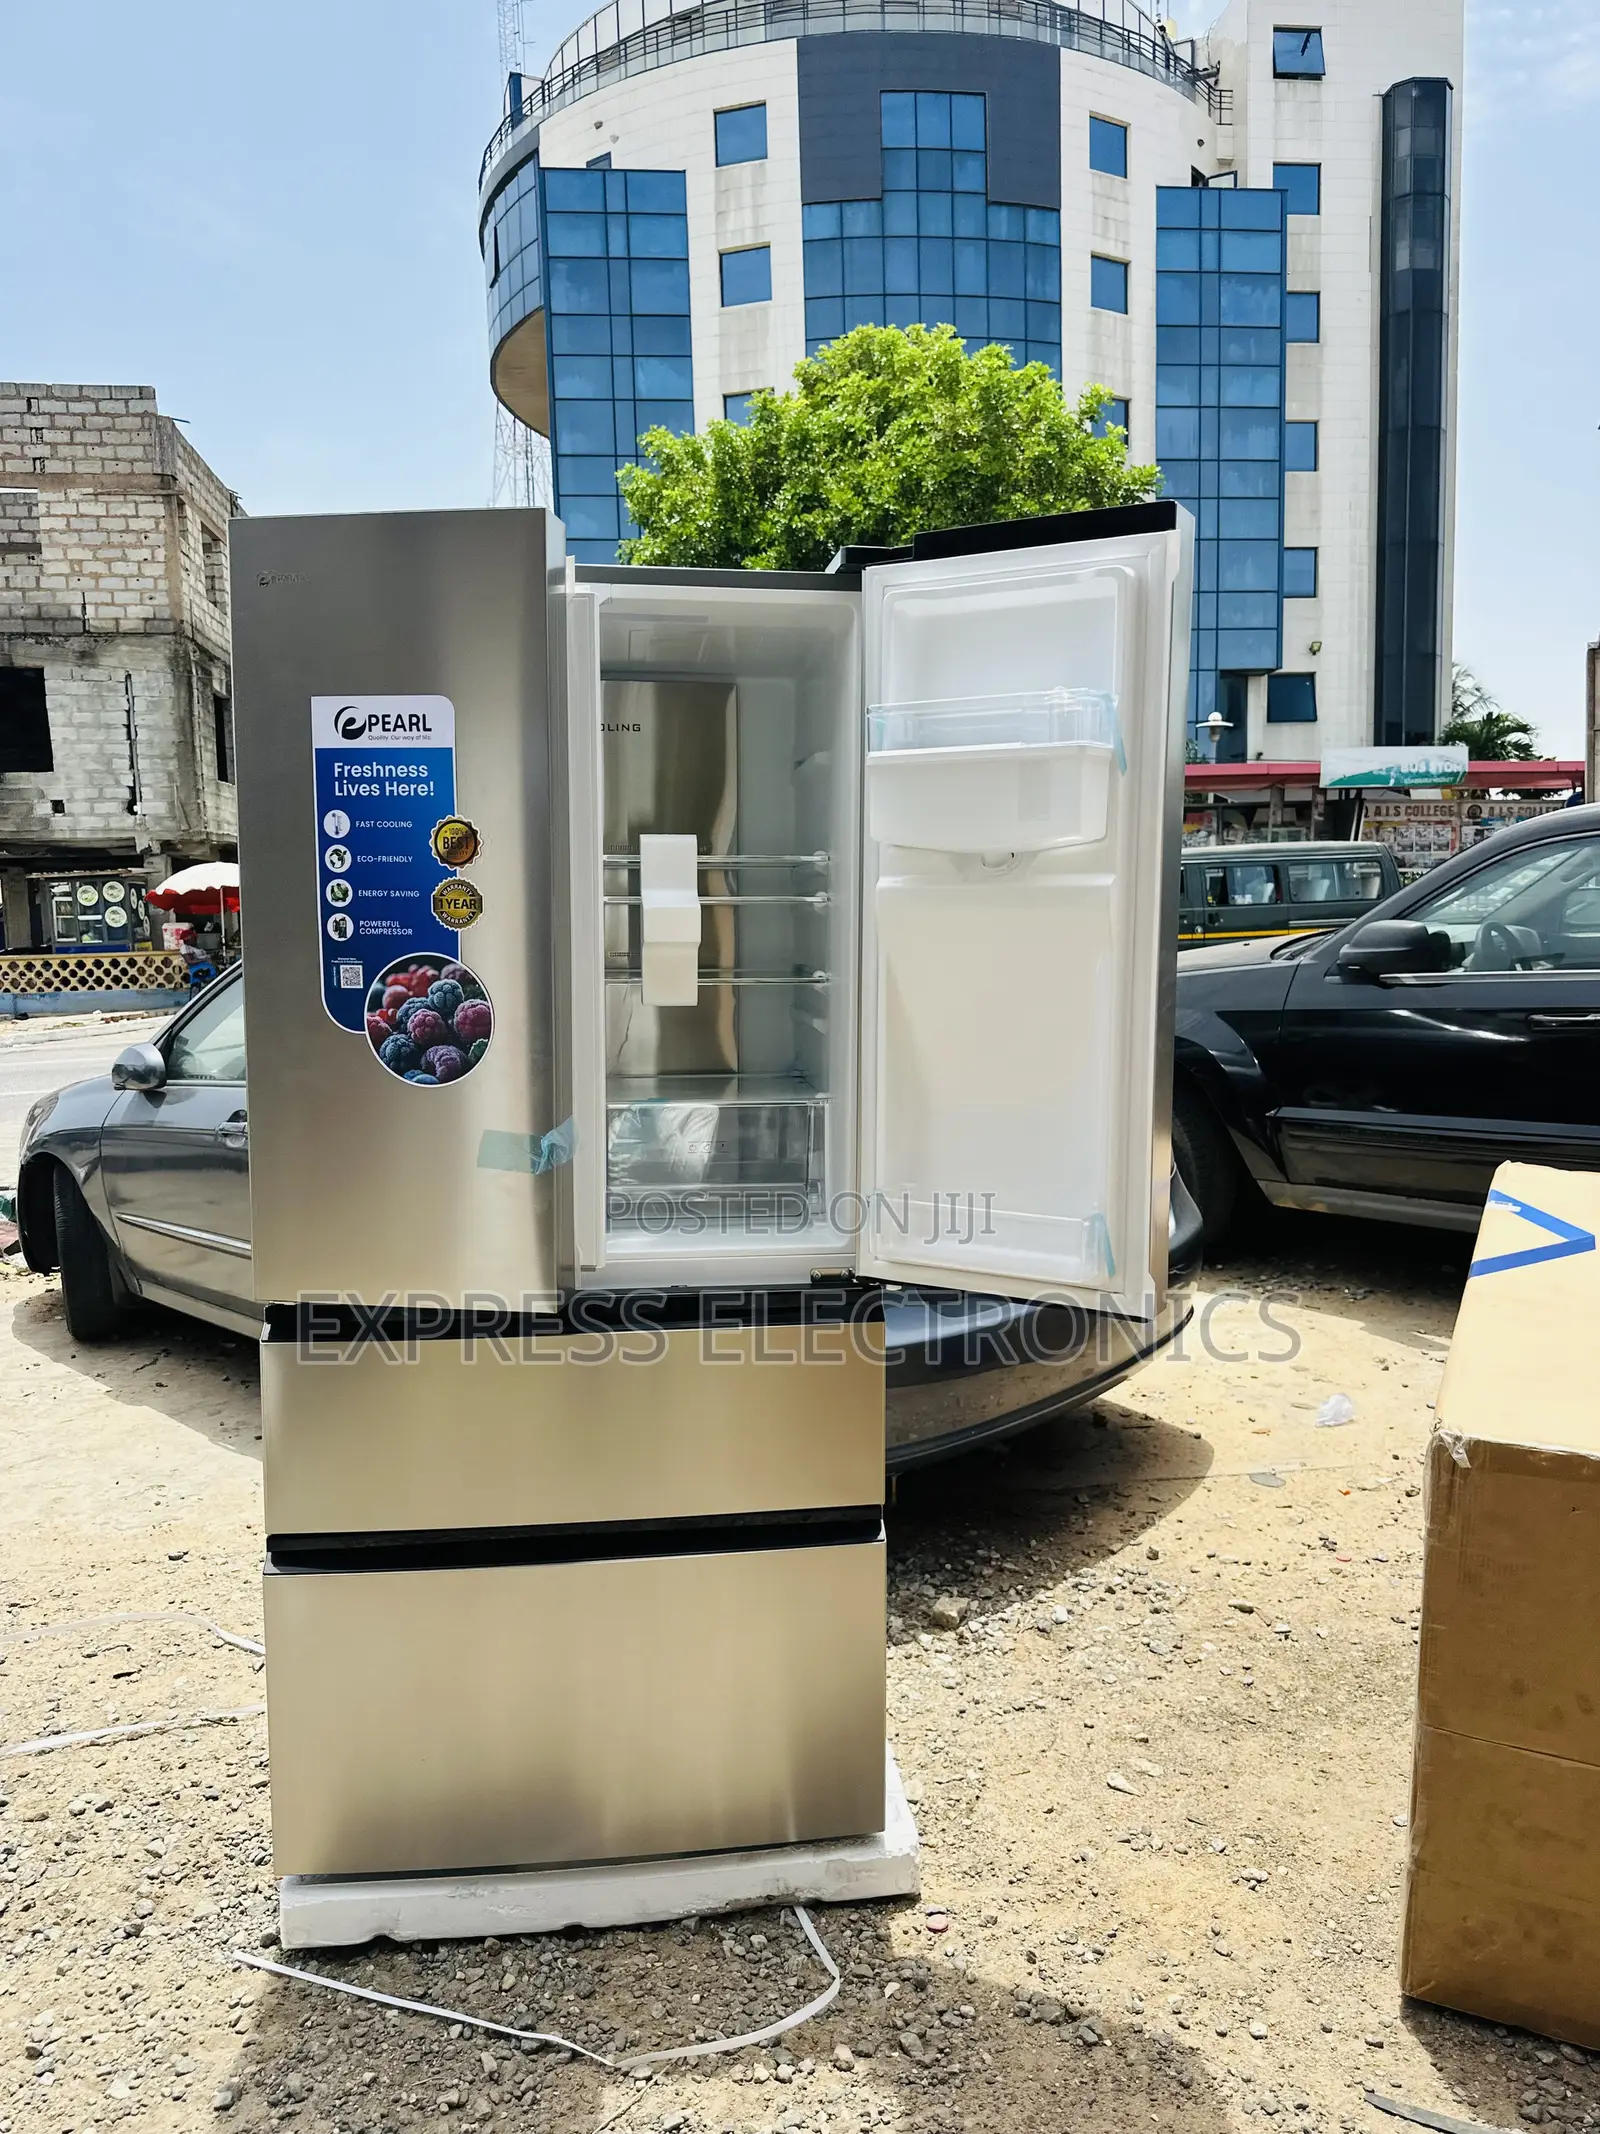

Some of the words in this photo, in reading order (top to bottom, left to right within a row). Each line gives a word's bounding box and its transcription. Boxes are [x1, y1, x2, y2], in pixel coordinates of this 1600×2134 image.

[367, 713, 432, 732] PEARL
[333, 761, 429, 778] Freshness
[334, 780, 381, 797] Lives
[384, 781, 435, 797] Here!
[1404, 804, 1455, 817] COLLEGE
[355, 820, 375, 829] FAST
[376, 820, 413, 829] COOLING
[442, 836, 470, 850] BEST
[356, 855, 413, 863] ECO-FRIENDLY
[390, 890, 420, 898] SAVING
[441, 884, 474, 896] WARRANTY
[446, 898, 478, 910] YEAR
[442, 911, 474, 924] WARRANTY
[359, 920, 401, 928] POWERFUL
[359, 928, 413, 936] COMPRESSOR
